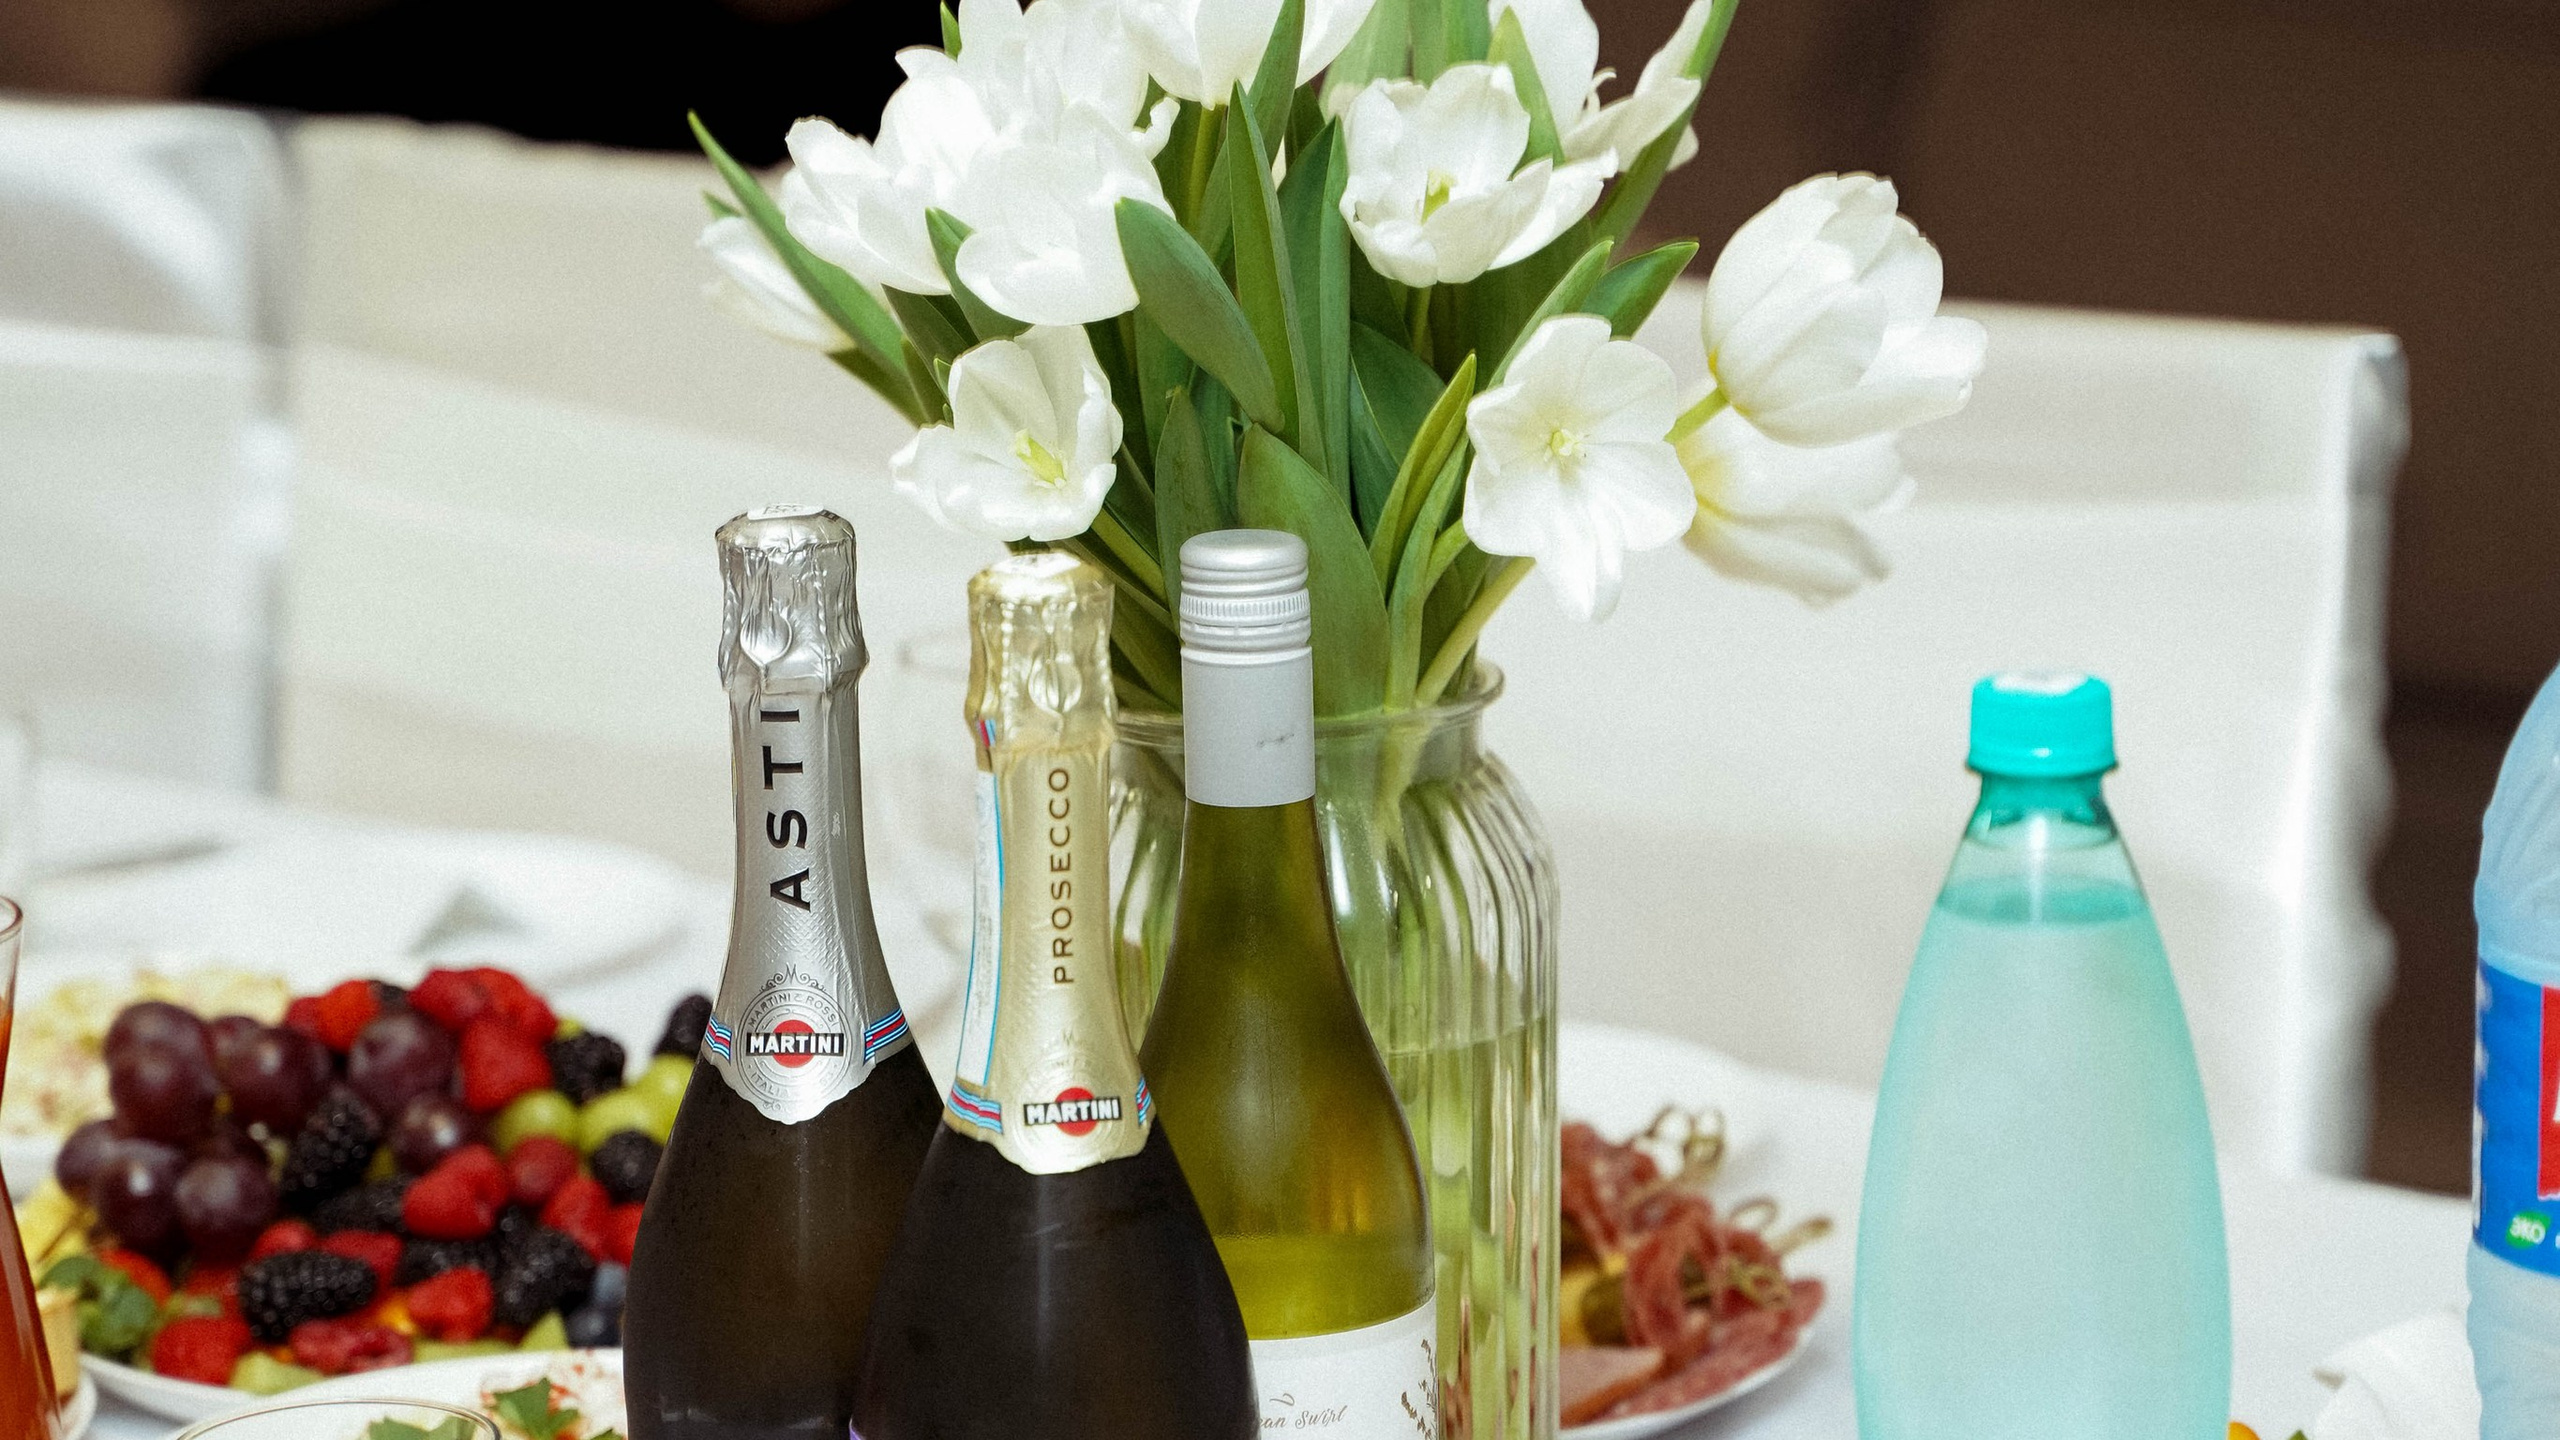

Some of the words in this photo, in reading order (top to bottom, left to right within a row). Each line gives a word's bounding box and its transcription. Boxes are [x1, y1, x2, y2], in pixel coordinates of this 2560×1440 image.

[760, 709, 811, 913] ASTI
[1049, 768, 1074, 984] PROSECCO
[748, 993, 791, 1028] MARTINI
[805, 995, 839, 1027] ROSSI
[750, 1035, 840, 1054] MARTINI
[1026, 1099, 1120, 1125] MARTINI
[1295, 1405, 1347, 1430] Swirl
